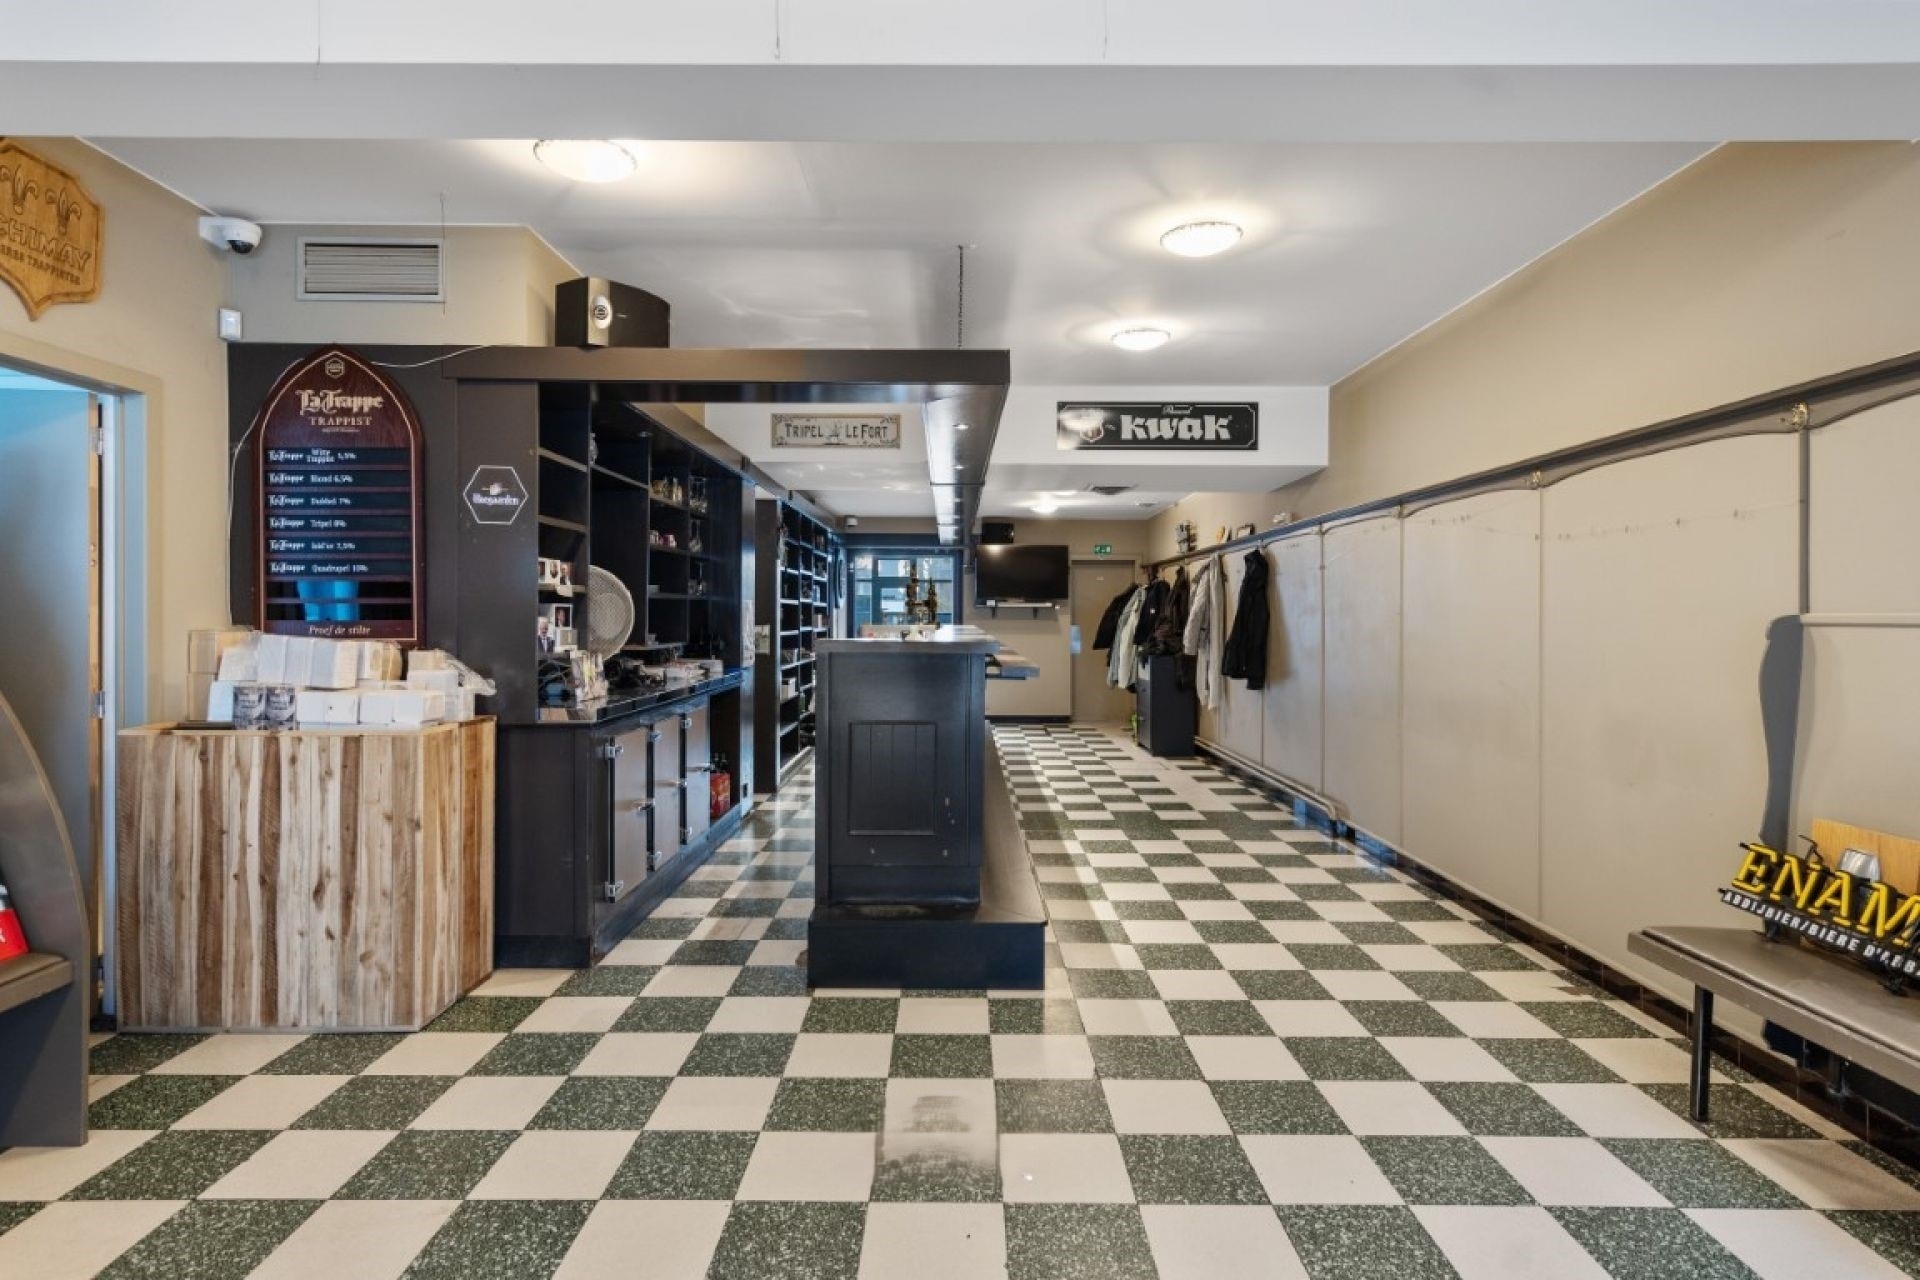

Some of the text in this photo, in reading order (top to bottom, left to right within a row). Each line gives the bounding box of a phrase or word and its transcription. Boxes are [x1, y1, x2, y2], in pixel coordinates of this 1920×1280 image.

[309, 416, 373, 426] TRAPPIST
[784, 423, 823, 438] TRIPEL
[1731, 843, 1920, 948] ENAM
